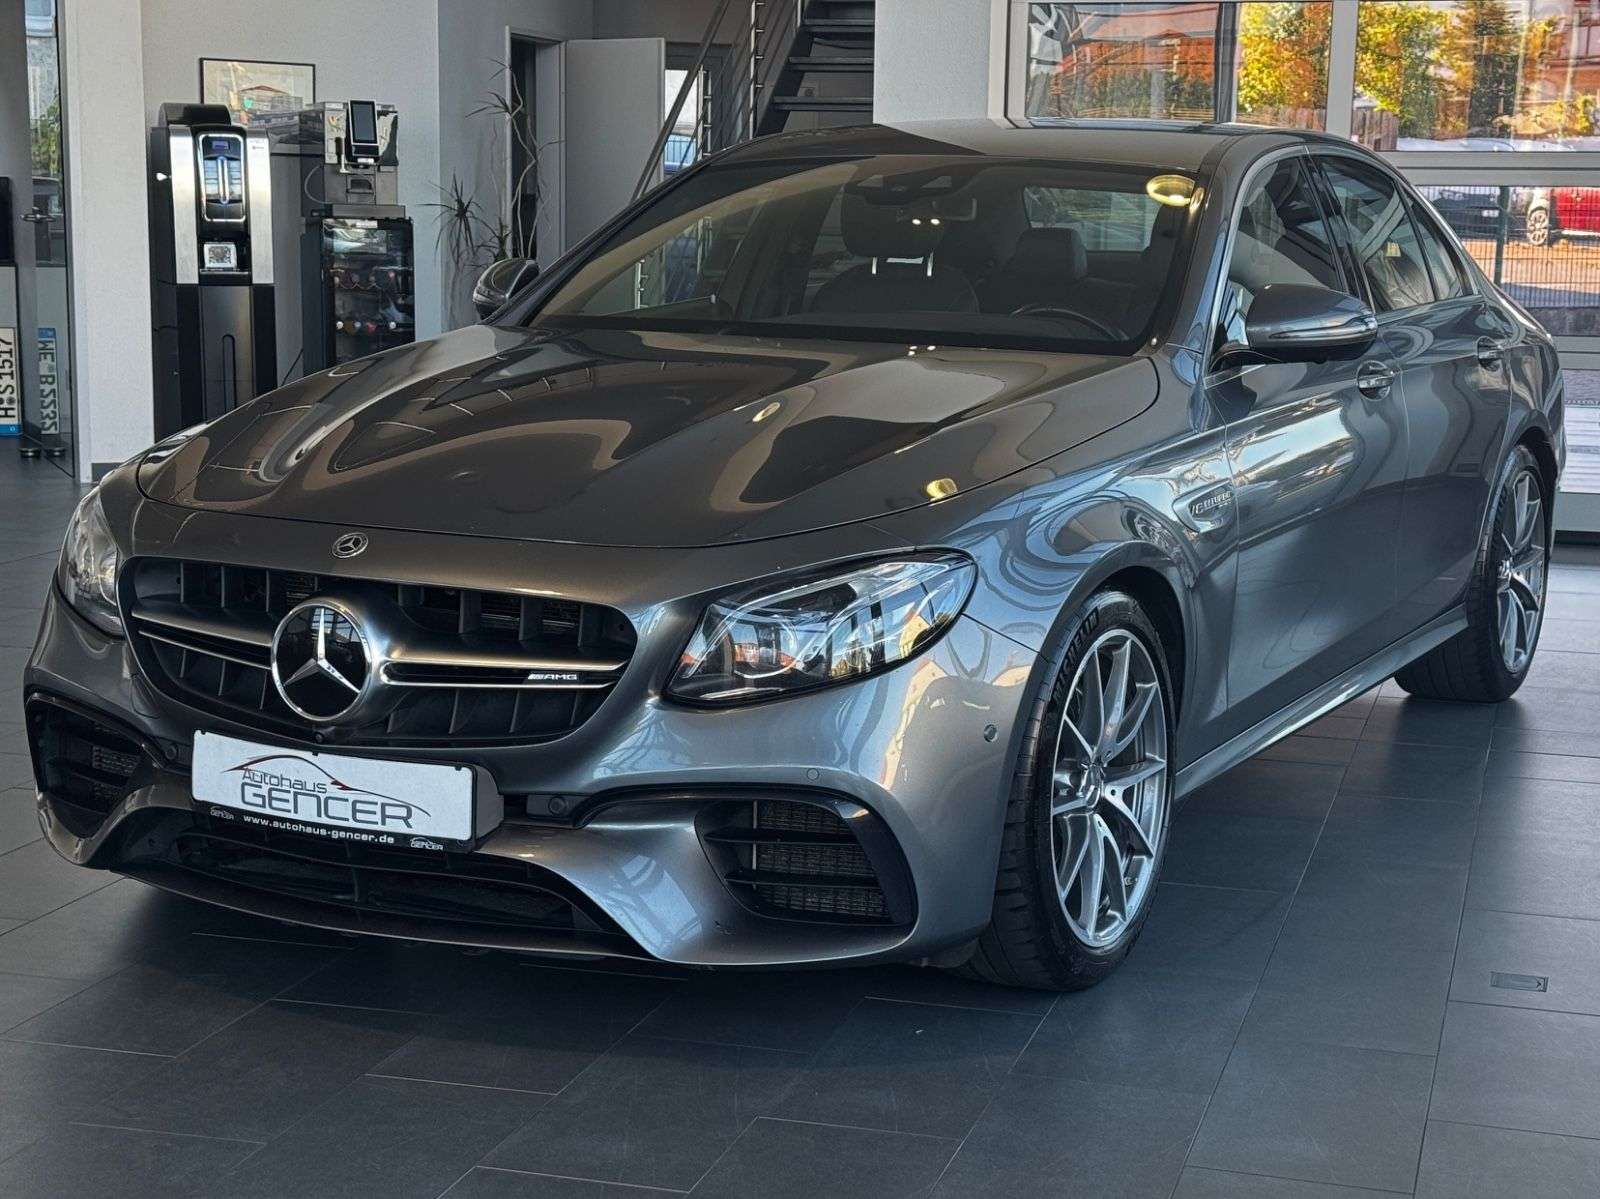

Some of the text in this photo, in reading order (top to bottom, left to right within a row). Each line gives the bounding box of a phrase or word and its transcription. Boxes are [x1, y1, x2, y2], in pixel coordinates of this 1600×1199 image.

[1052, 611, 1099, 704] MICHELIN
[543, 673, 577, 681] AMG
[242, 769, 327, 794] Autohaus
[240, 782, 414, 829] GENCER
[243, 814, 395, 845] www.autohaus-gencer.de
